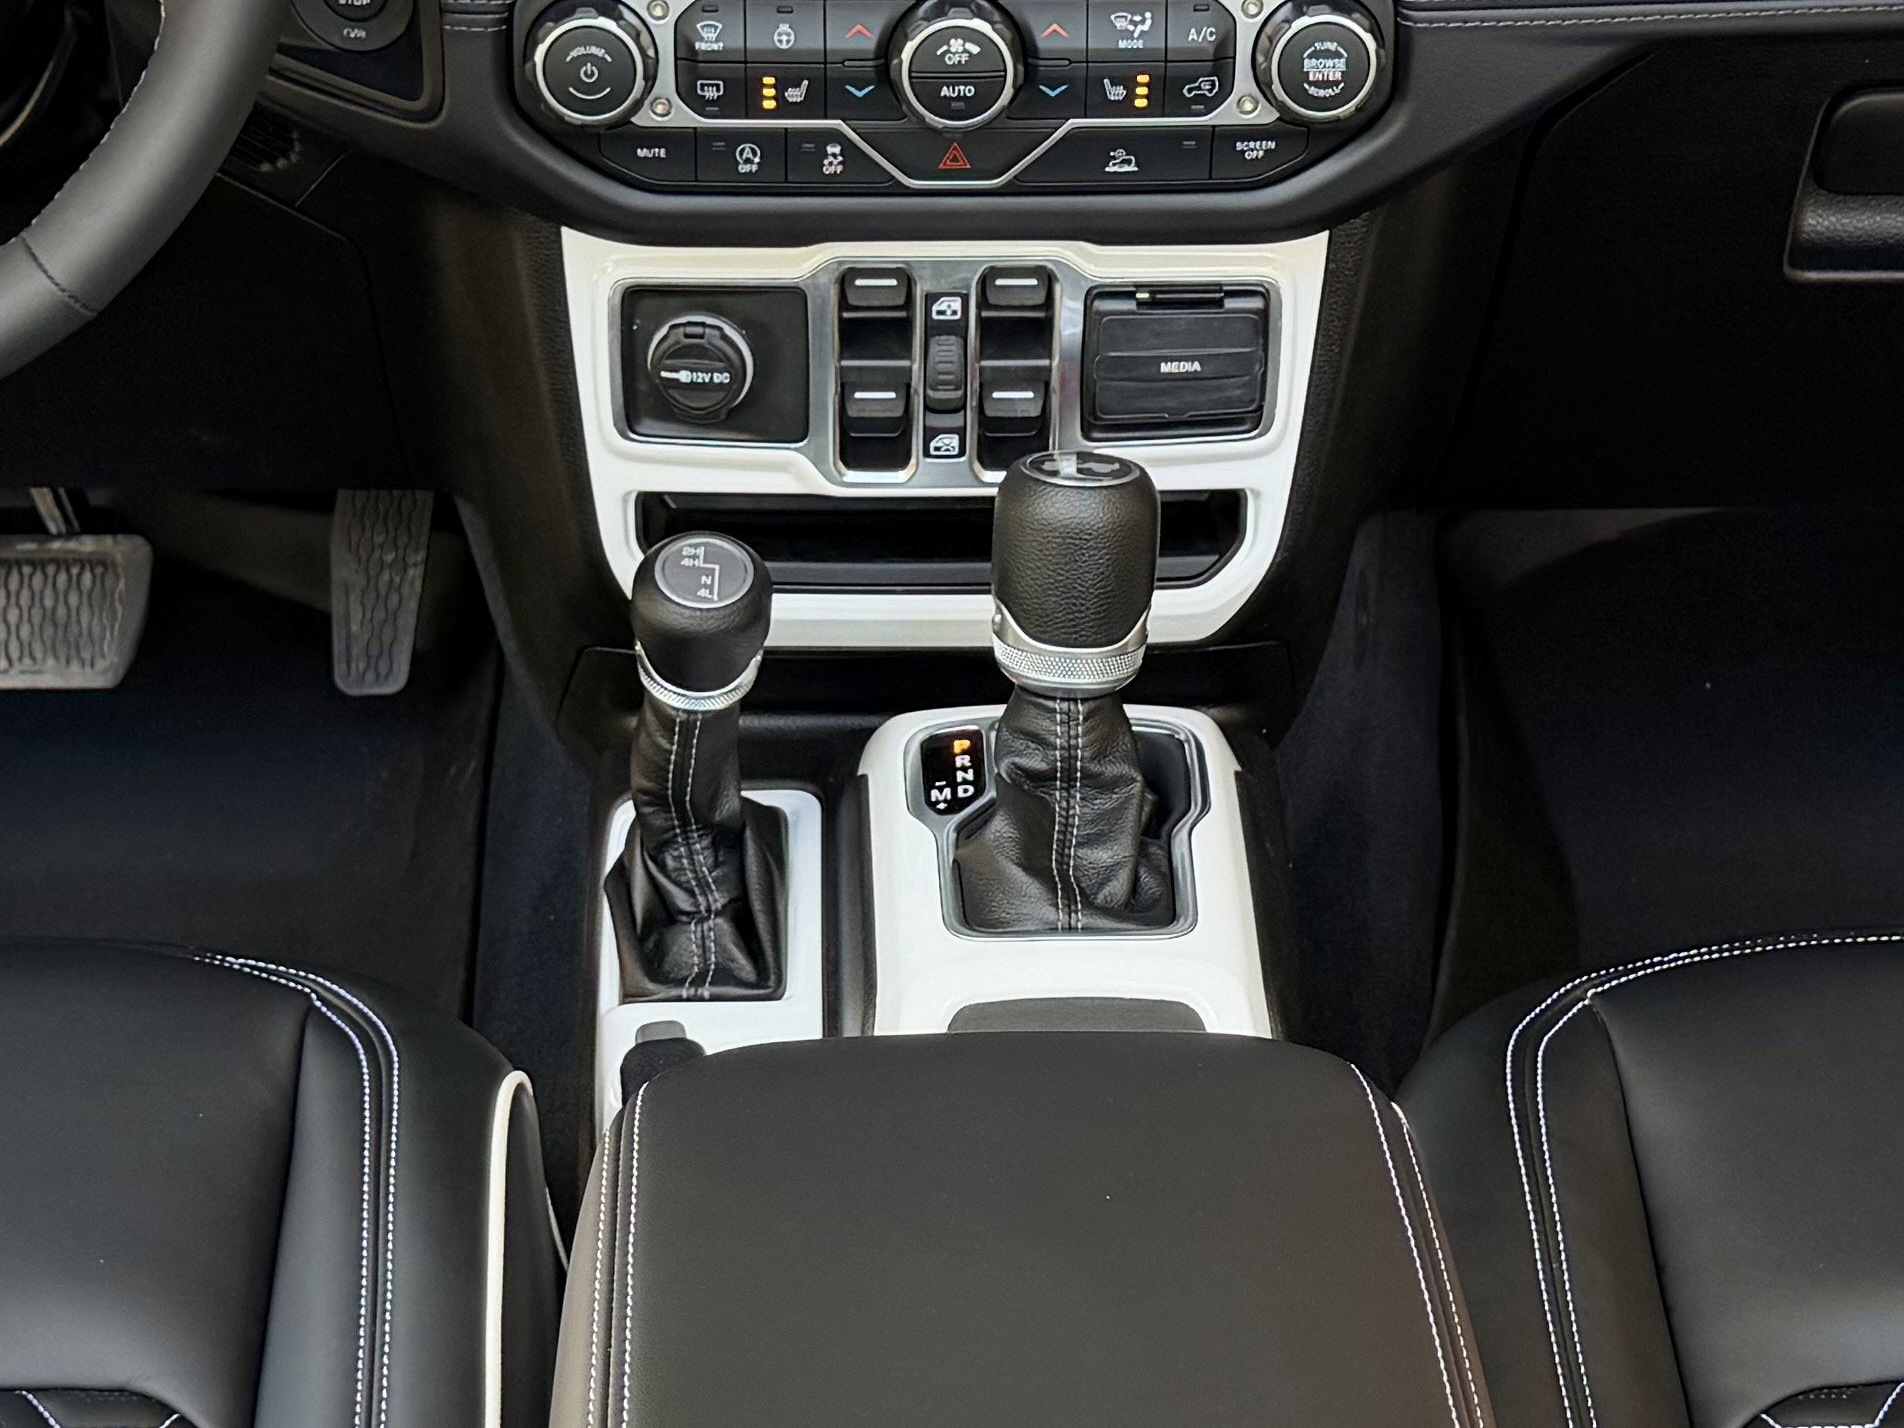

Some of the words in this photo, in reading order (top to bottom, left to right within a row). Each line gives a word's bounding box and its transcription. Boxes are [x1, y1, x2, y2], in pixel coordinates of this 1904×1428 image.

[1187, 27, 1217, 43] A/C
[694, 41, 725, 52] FRONT
[1118, 39, 1144, 50] MODE
[944, 53, 970, 66] OFF
[1303, 58, 1347, 70] BROWSE
[1308, 70, 1342, 82] ENTER
[940, 84, 976, 98] AUTO
[1235, 141, 1276, 151] SCREEN
[636, 147, 667, 159] MUTE
[1244, 150, 1265, 160] OFF
[738, 162, 759, 174] OFF
[822, 163, 844, 175] OFF
[1160, 360, 1202, 373] MEDIA
[692, 371, 711, 384] 12V
[713, 371, 730, 384] DC
[680, 557, 699, 567] 4H
[700, 574, 712, 585] N
[696, 587, 713, 599] 4L
[953, 739, 971, 754] P
[955, 754, 972, 768] R
[956, 768, 975, 783] N
[930, 787, 952, 802] M
[957, 784, 975, 798] D
